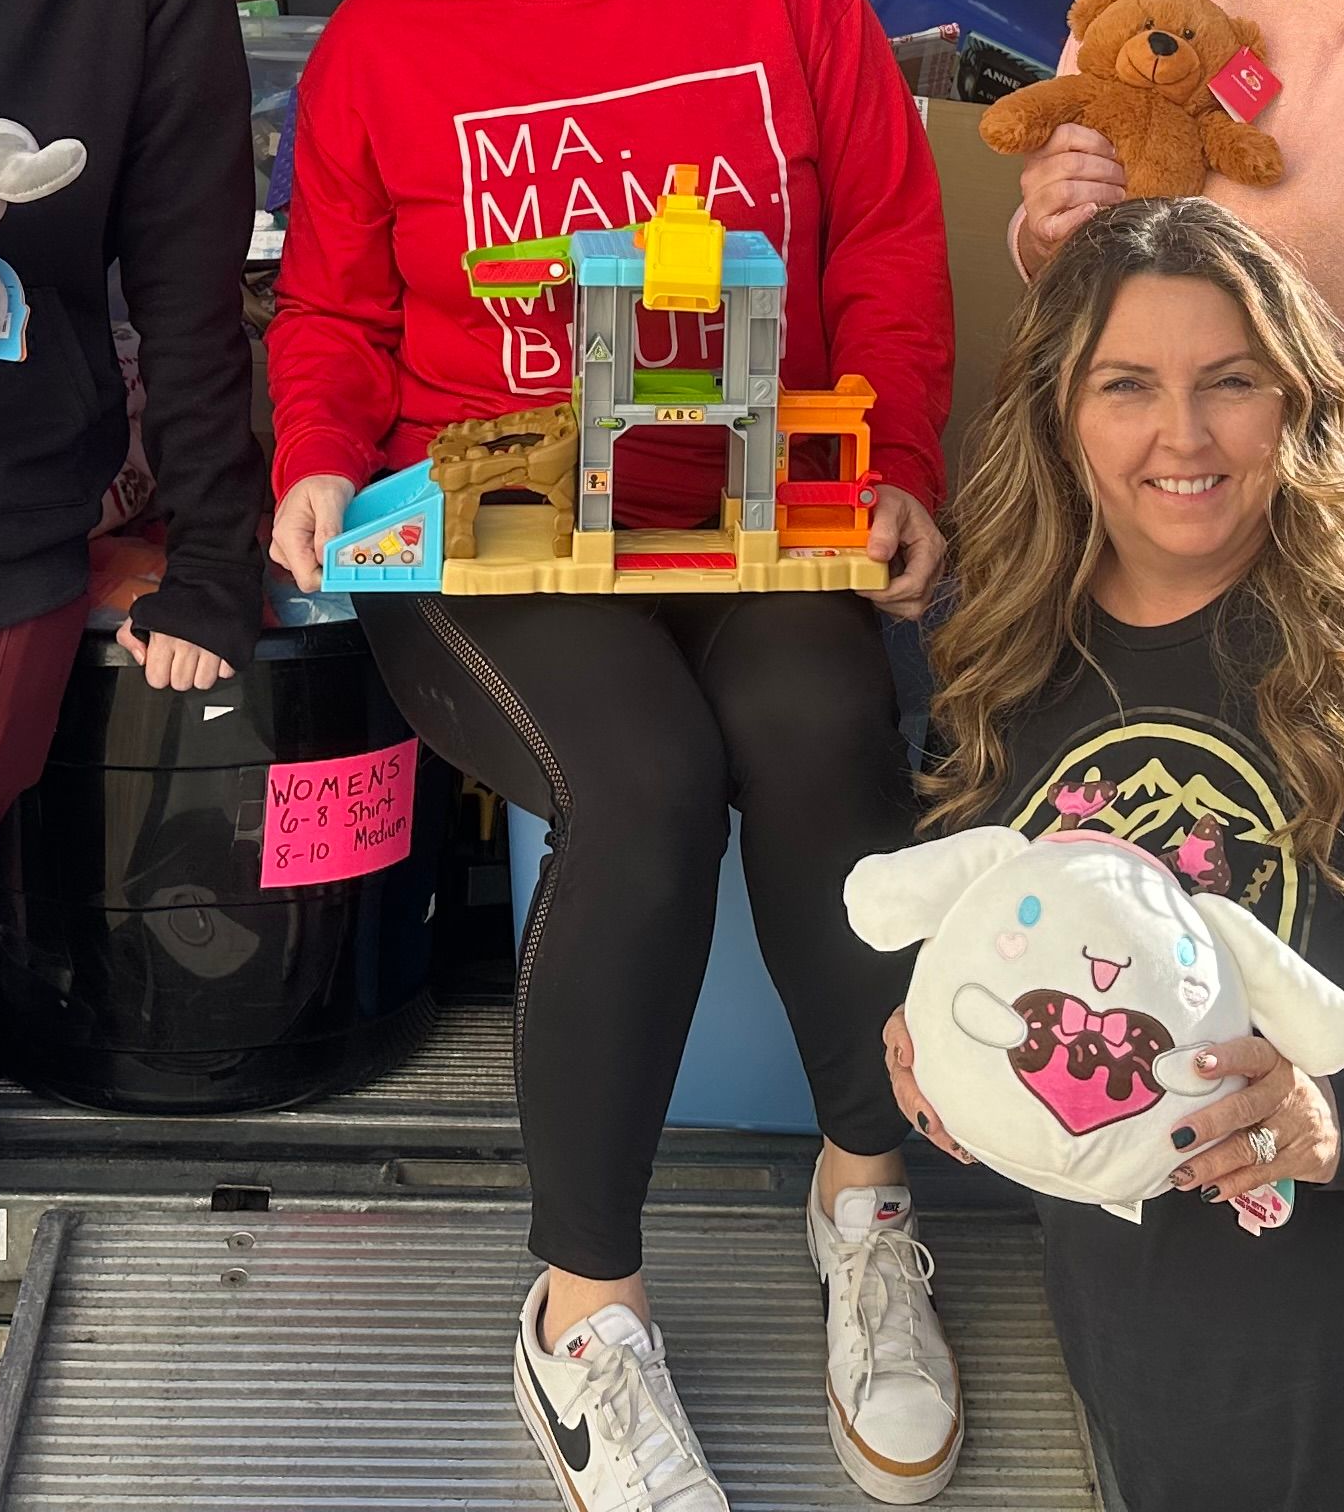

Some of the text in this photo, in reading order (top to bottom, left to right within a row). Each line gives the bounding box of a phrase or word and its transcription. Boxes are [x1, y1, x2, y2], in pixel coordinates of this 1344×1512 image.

[474, 116, 633, 182] MA.
[270, 754, 400, 808] WOMENS
[353, 815, 407, 852] Medium
